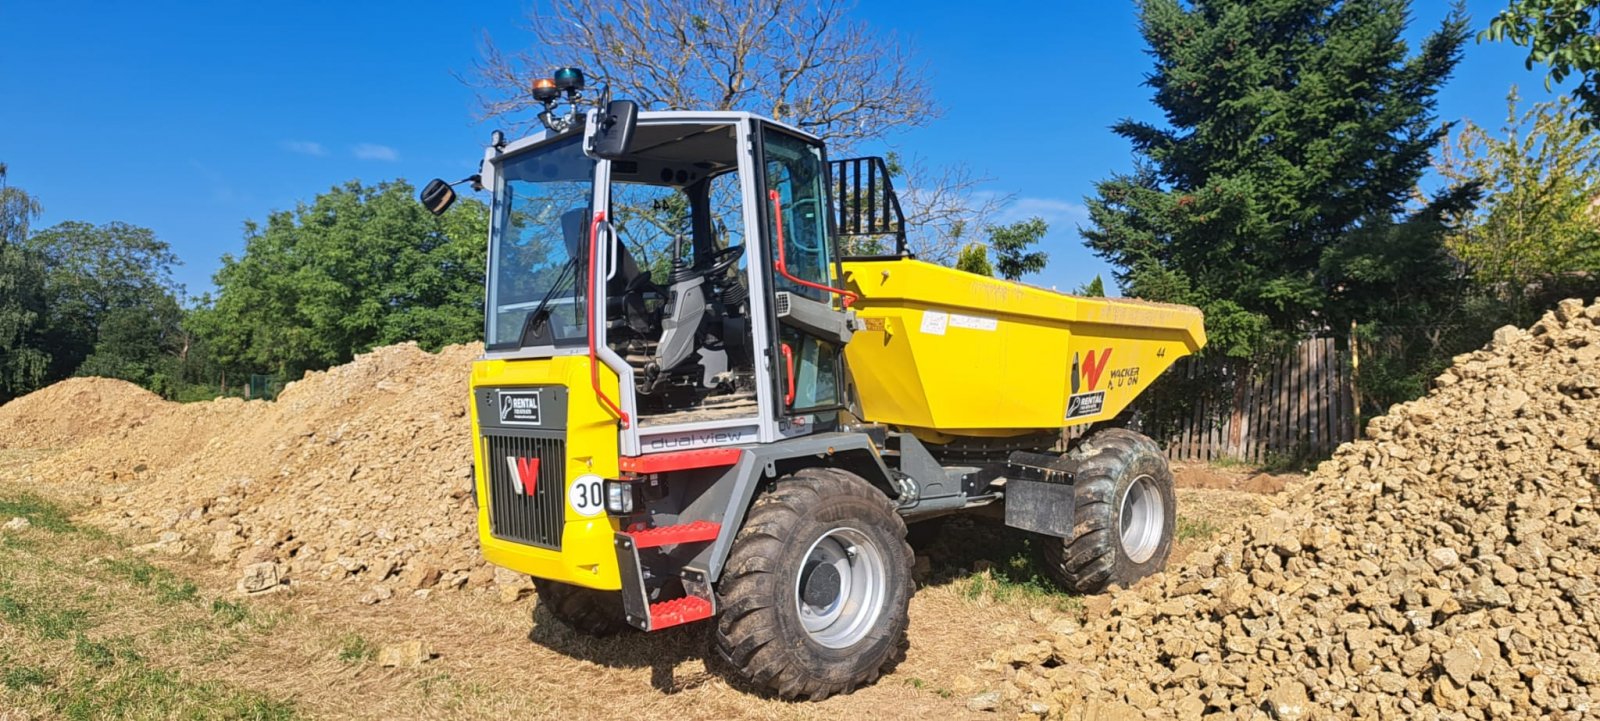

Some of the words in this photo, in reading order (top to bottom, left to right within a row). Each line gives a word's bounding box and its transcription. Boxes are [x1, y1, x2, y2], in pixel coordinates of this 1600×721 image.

[1156, 347, 1165, 358] 44
[513, 397, 537, 408] RENTAL
[1080, 395, 1102, 405] RENTAL
[651, 434, 695, 449] dual
[697, 431, 741, 444] view
[576, 482, 602, 508] 30
